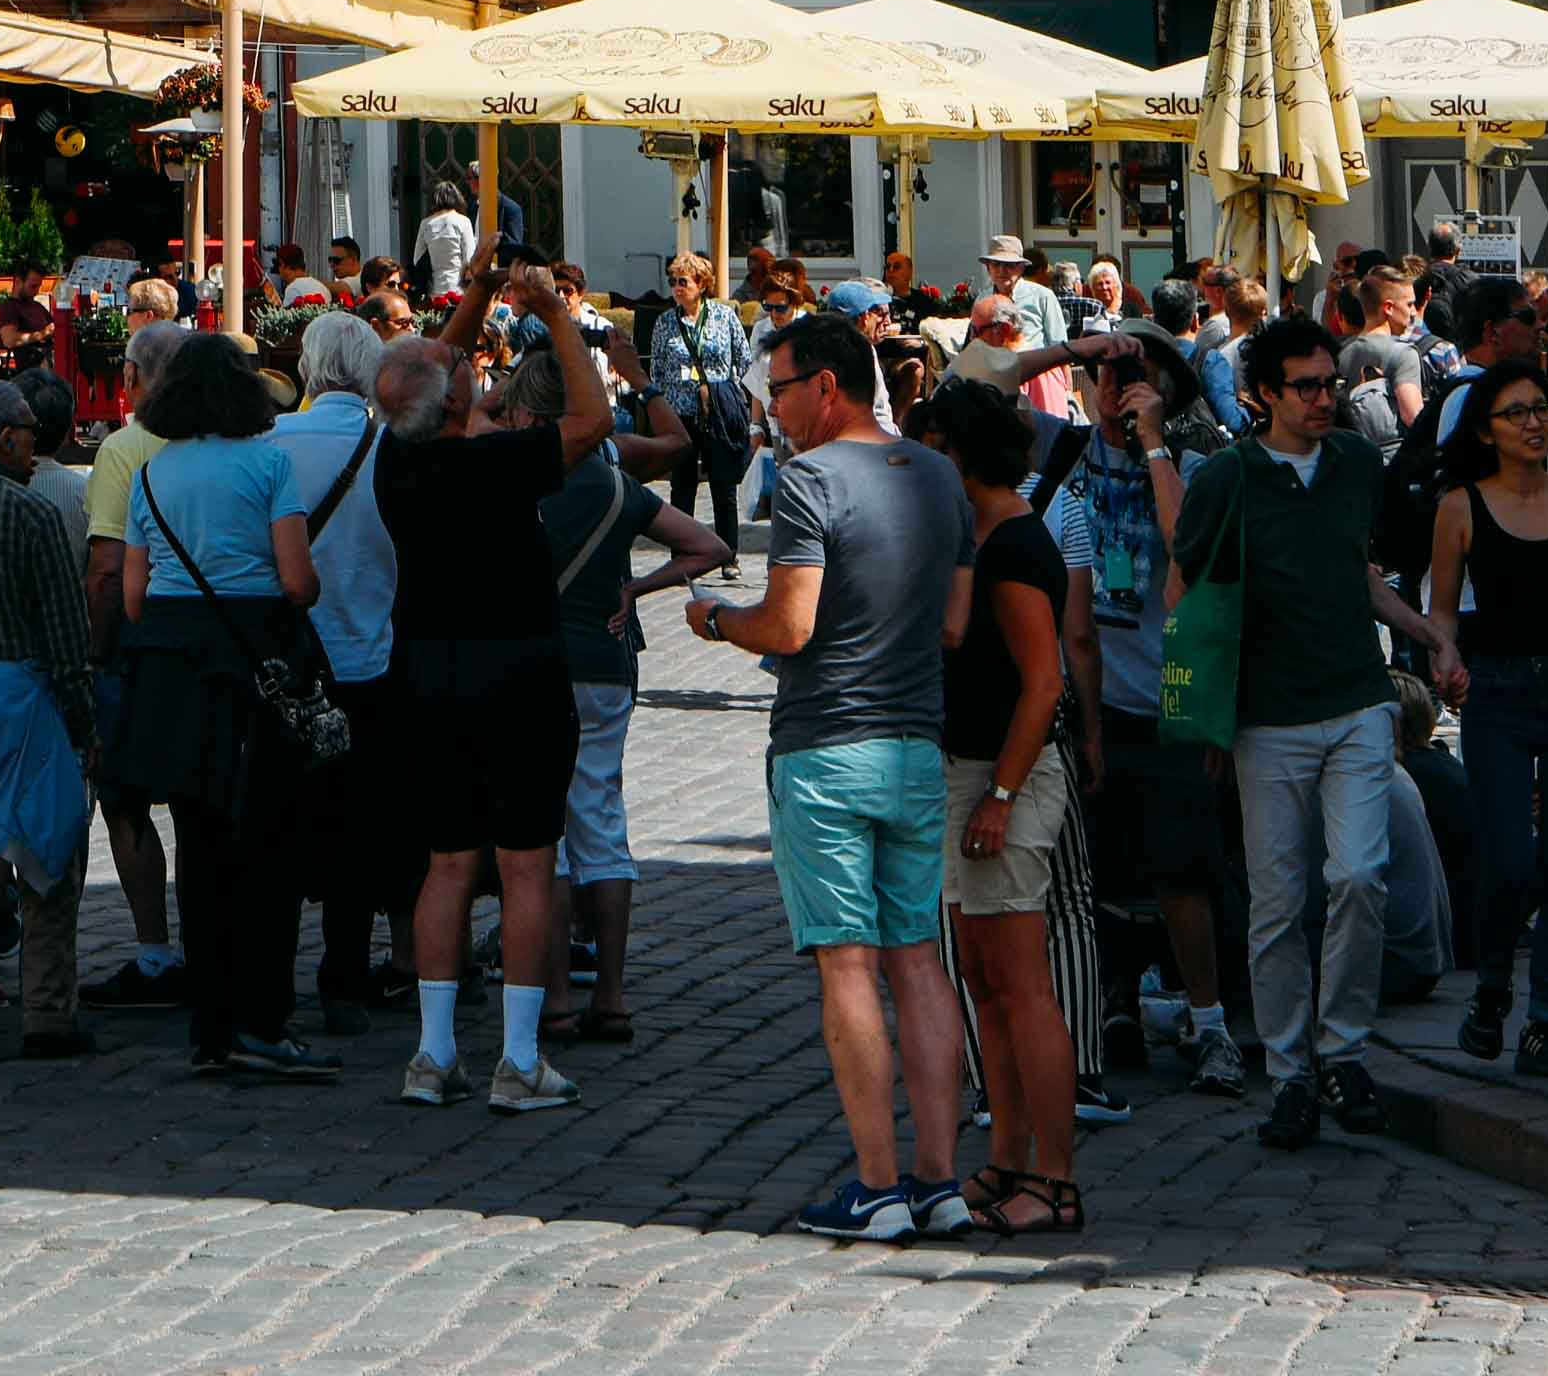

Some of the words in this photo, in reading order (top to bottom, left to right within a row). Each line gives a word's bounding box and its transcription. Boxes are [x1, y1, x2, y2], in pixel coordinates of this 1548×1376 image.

[341, 90, 397, 113] saku
[481, 91, 538, 115] saku
[624, 93, 682, 116] saku
[768, 93, 825, 117] saku
[1144, 92, 1200, 116] saku
[1430, 94, 1487, 117] saku
